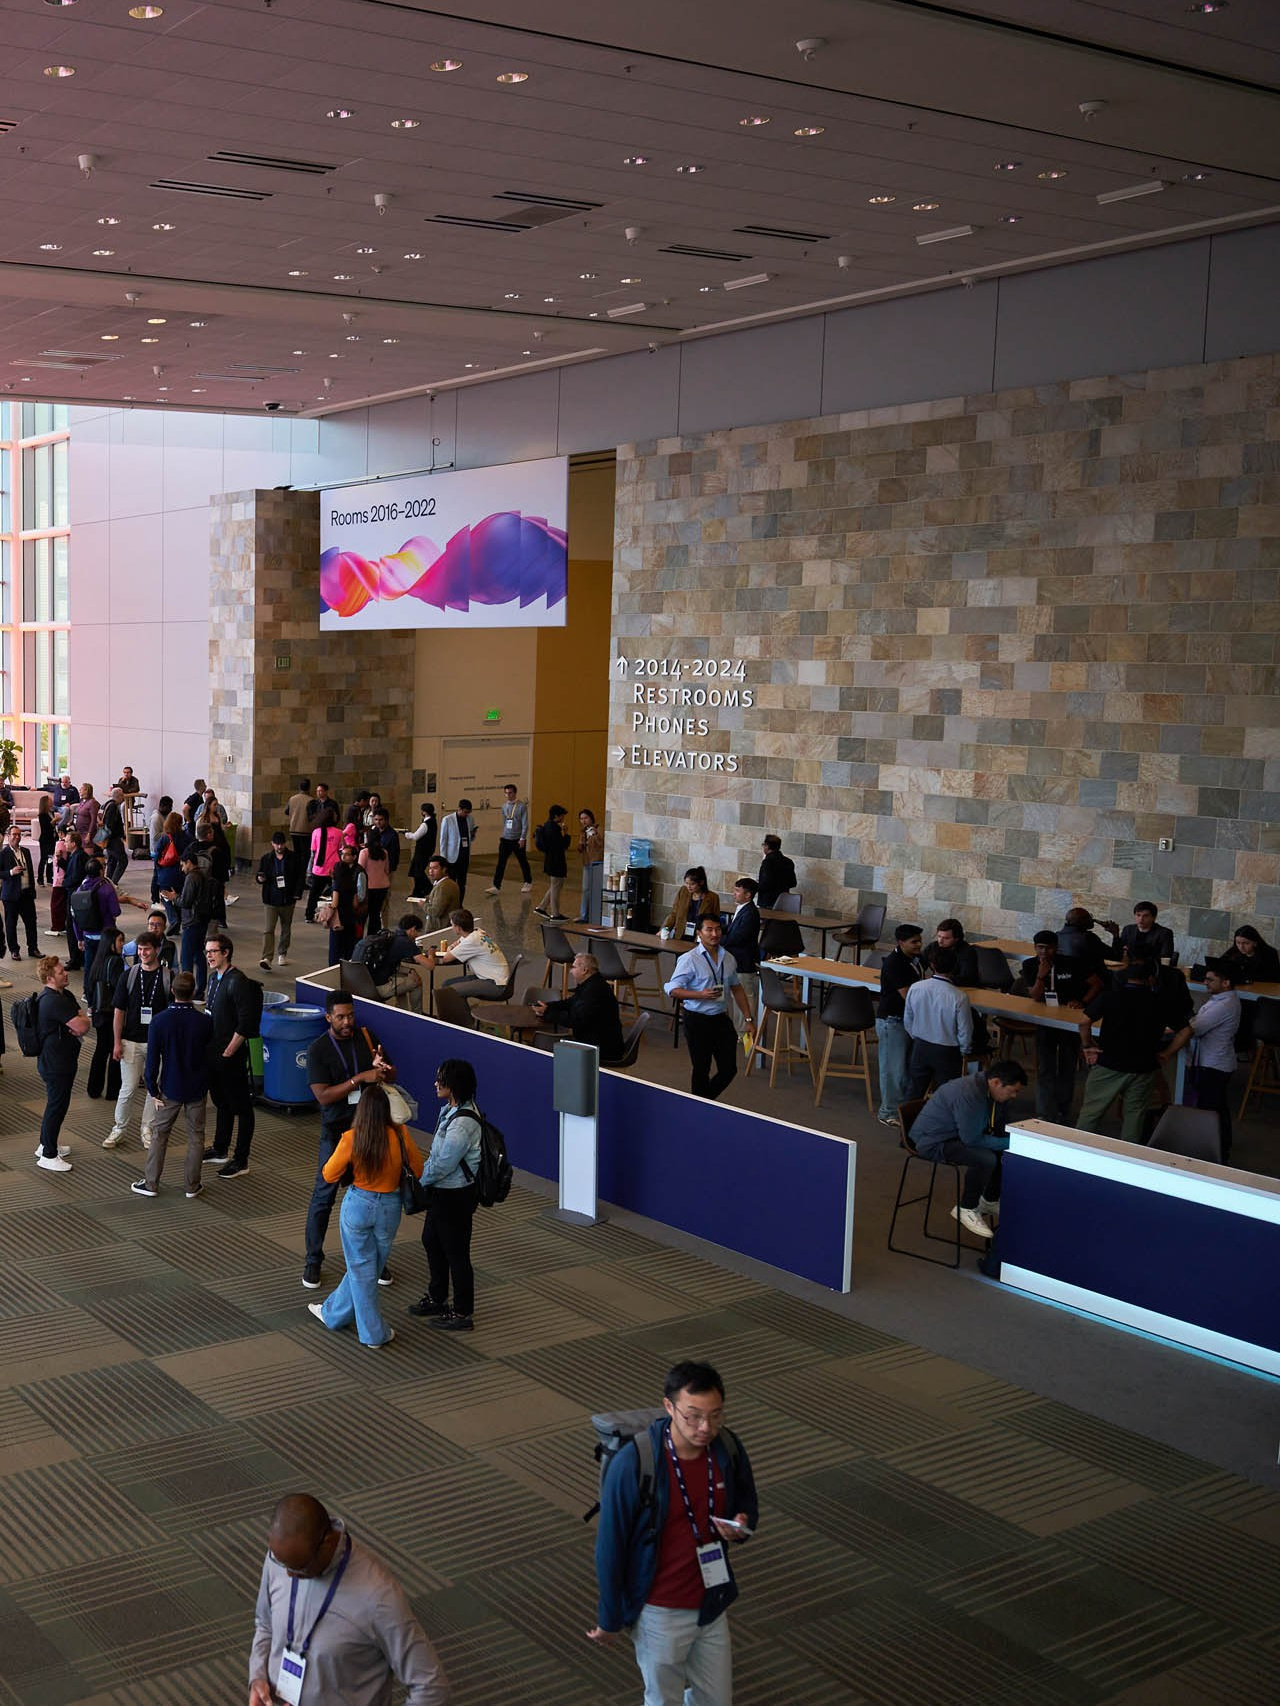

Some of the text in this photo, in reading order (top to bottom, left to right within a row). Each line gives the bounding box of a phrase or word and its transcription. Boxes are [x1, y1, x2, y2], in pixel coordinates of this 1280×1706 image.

[331, 509, 369, 527] Rooms
[634, 658, 748, 683] 2014-2024
[633, 683, 754, 709] RESTROOMS
[632, 711, 710, 736] PHONES
[631, 744, 740, 772] ELEVATORS
